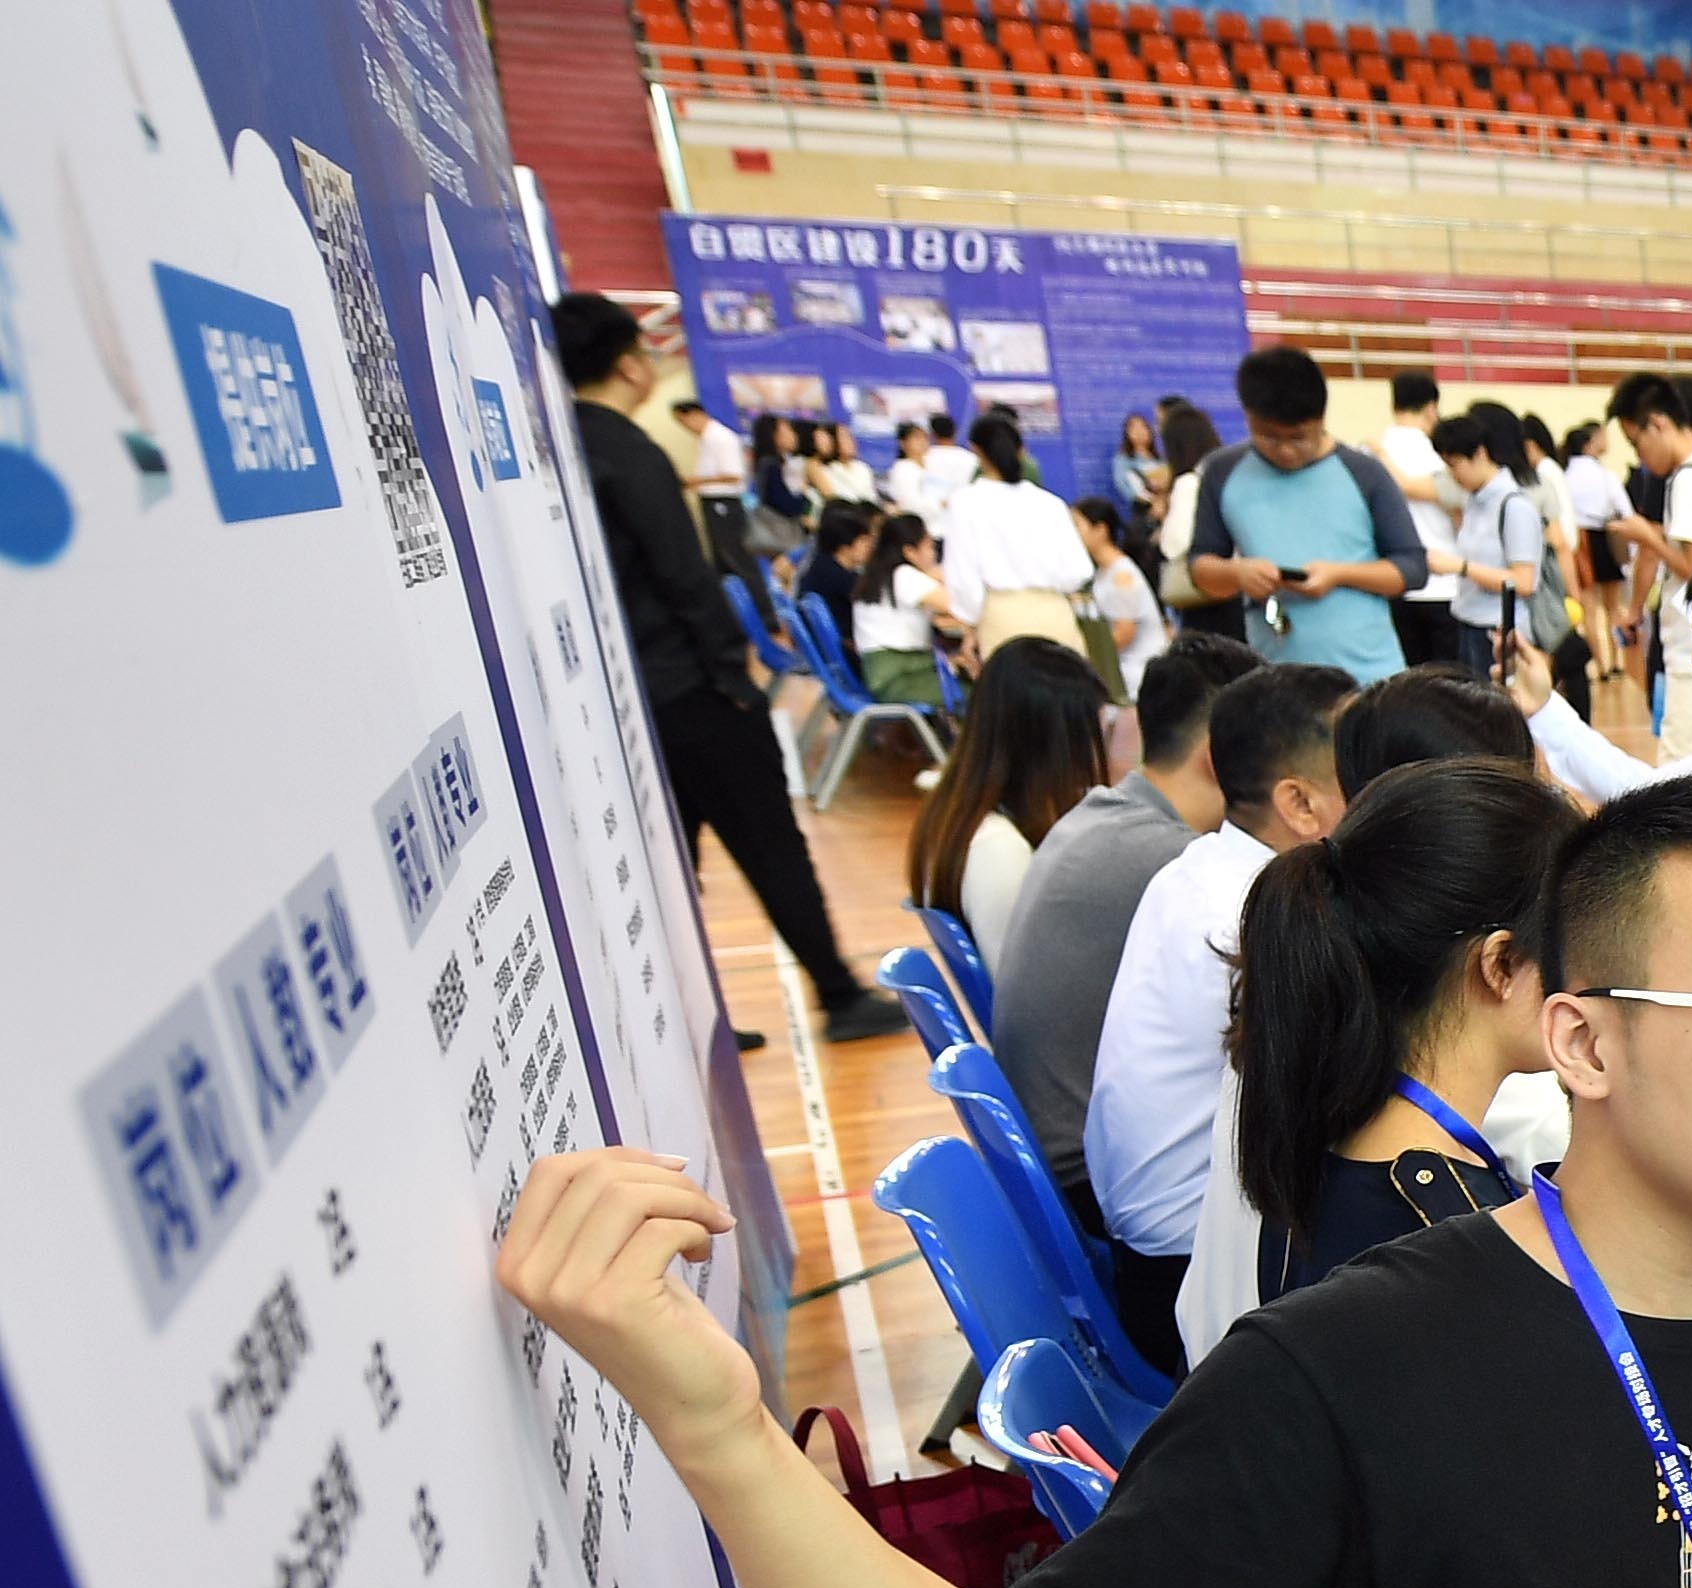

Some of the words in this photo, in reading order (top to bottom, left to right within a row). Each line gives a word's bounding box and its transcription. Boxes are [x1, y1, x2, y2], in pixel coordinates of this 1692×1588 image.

[388, 806, 435, 919] 岗位
[440, 739, 480, 832] 专业
[114, 1040, 236, 1265] 岗位
[251, 954, 318, 1133] 人数
[301, 891, 368, 1036] 专业
